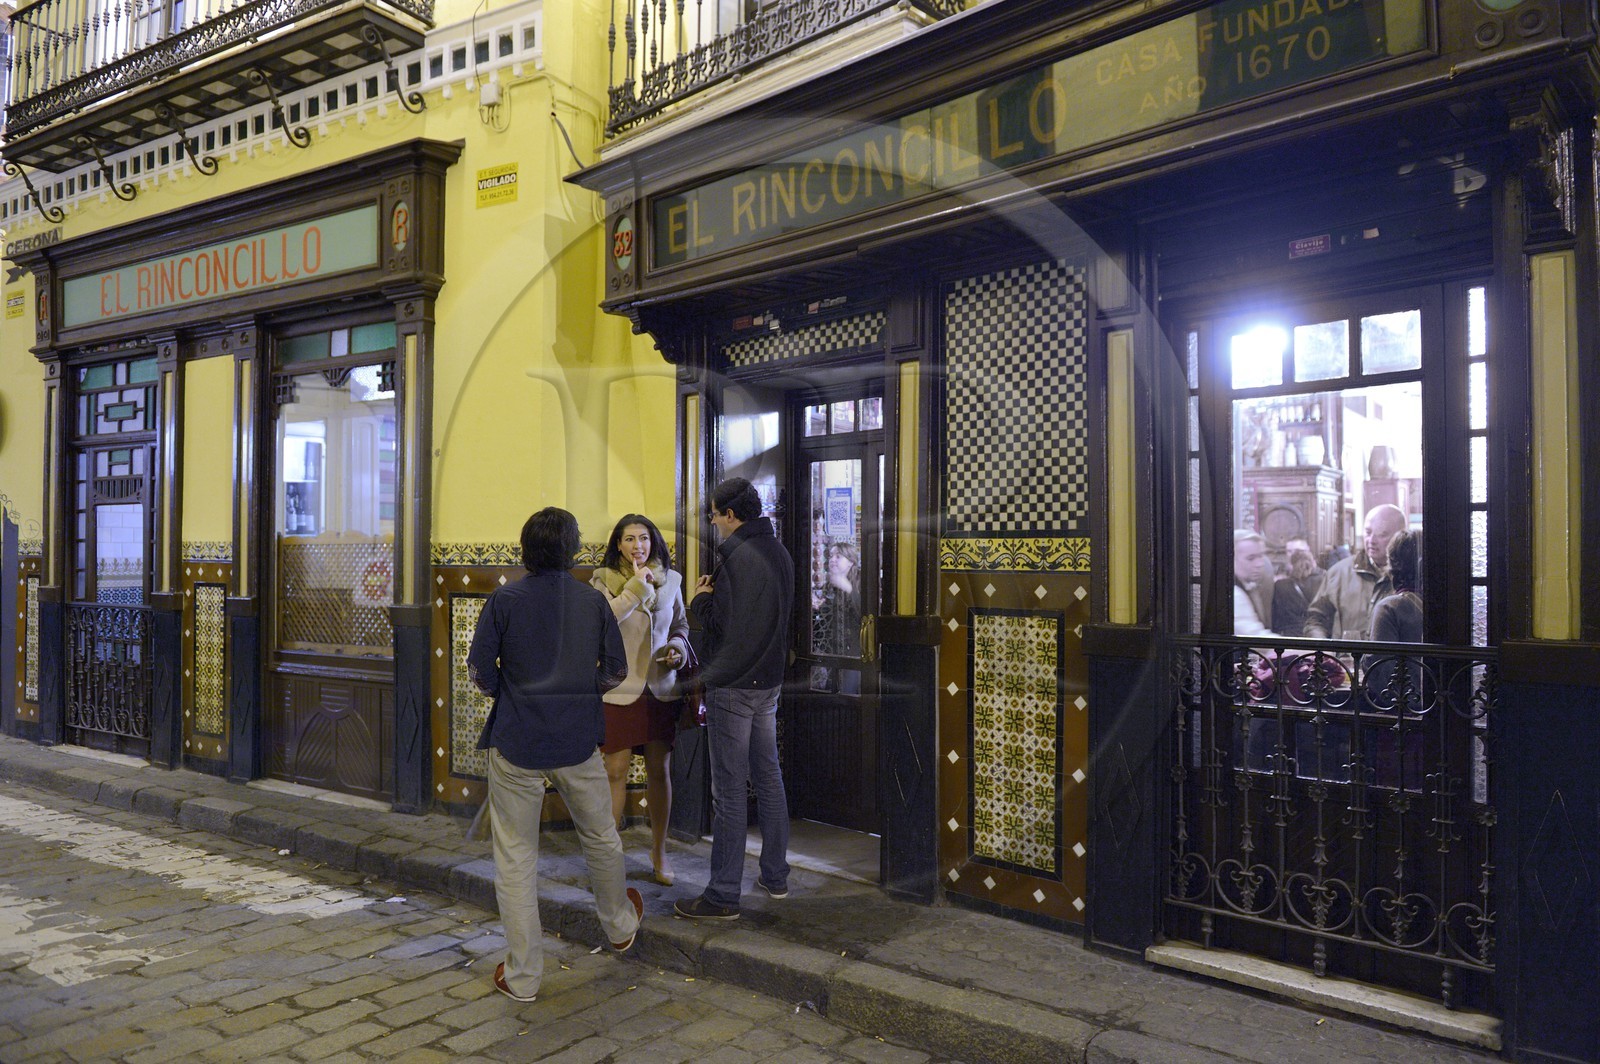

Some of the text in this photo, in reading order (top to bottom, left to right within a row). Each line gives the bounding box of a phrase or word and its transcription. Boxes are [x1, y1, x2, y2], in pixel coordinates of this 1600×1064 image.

[1096, 37, 1183, 86] CASA
[1140, 25, 1331, 114] AÑO 1670
[478, 173, 517, 190] VIGILADO
[668, 78, 1066, 255] EL RINCONCILLO
[393, 207, 409, 245] R
[613, 230, 633, 257] 32
[101, 225, 322, 317] EL RINCONCILLO
